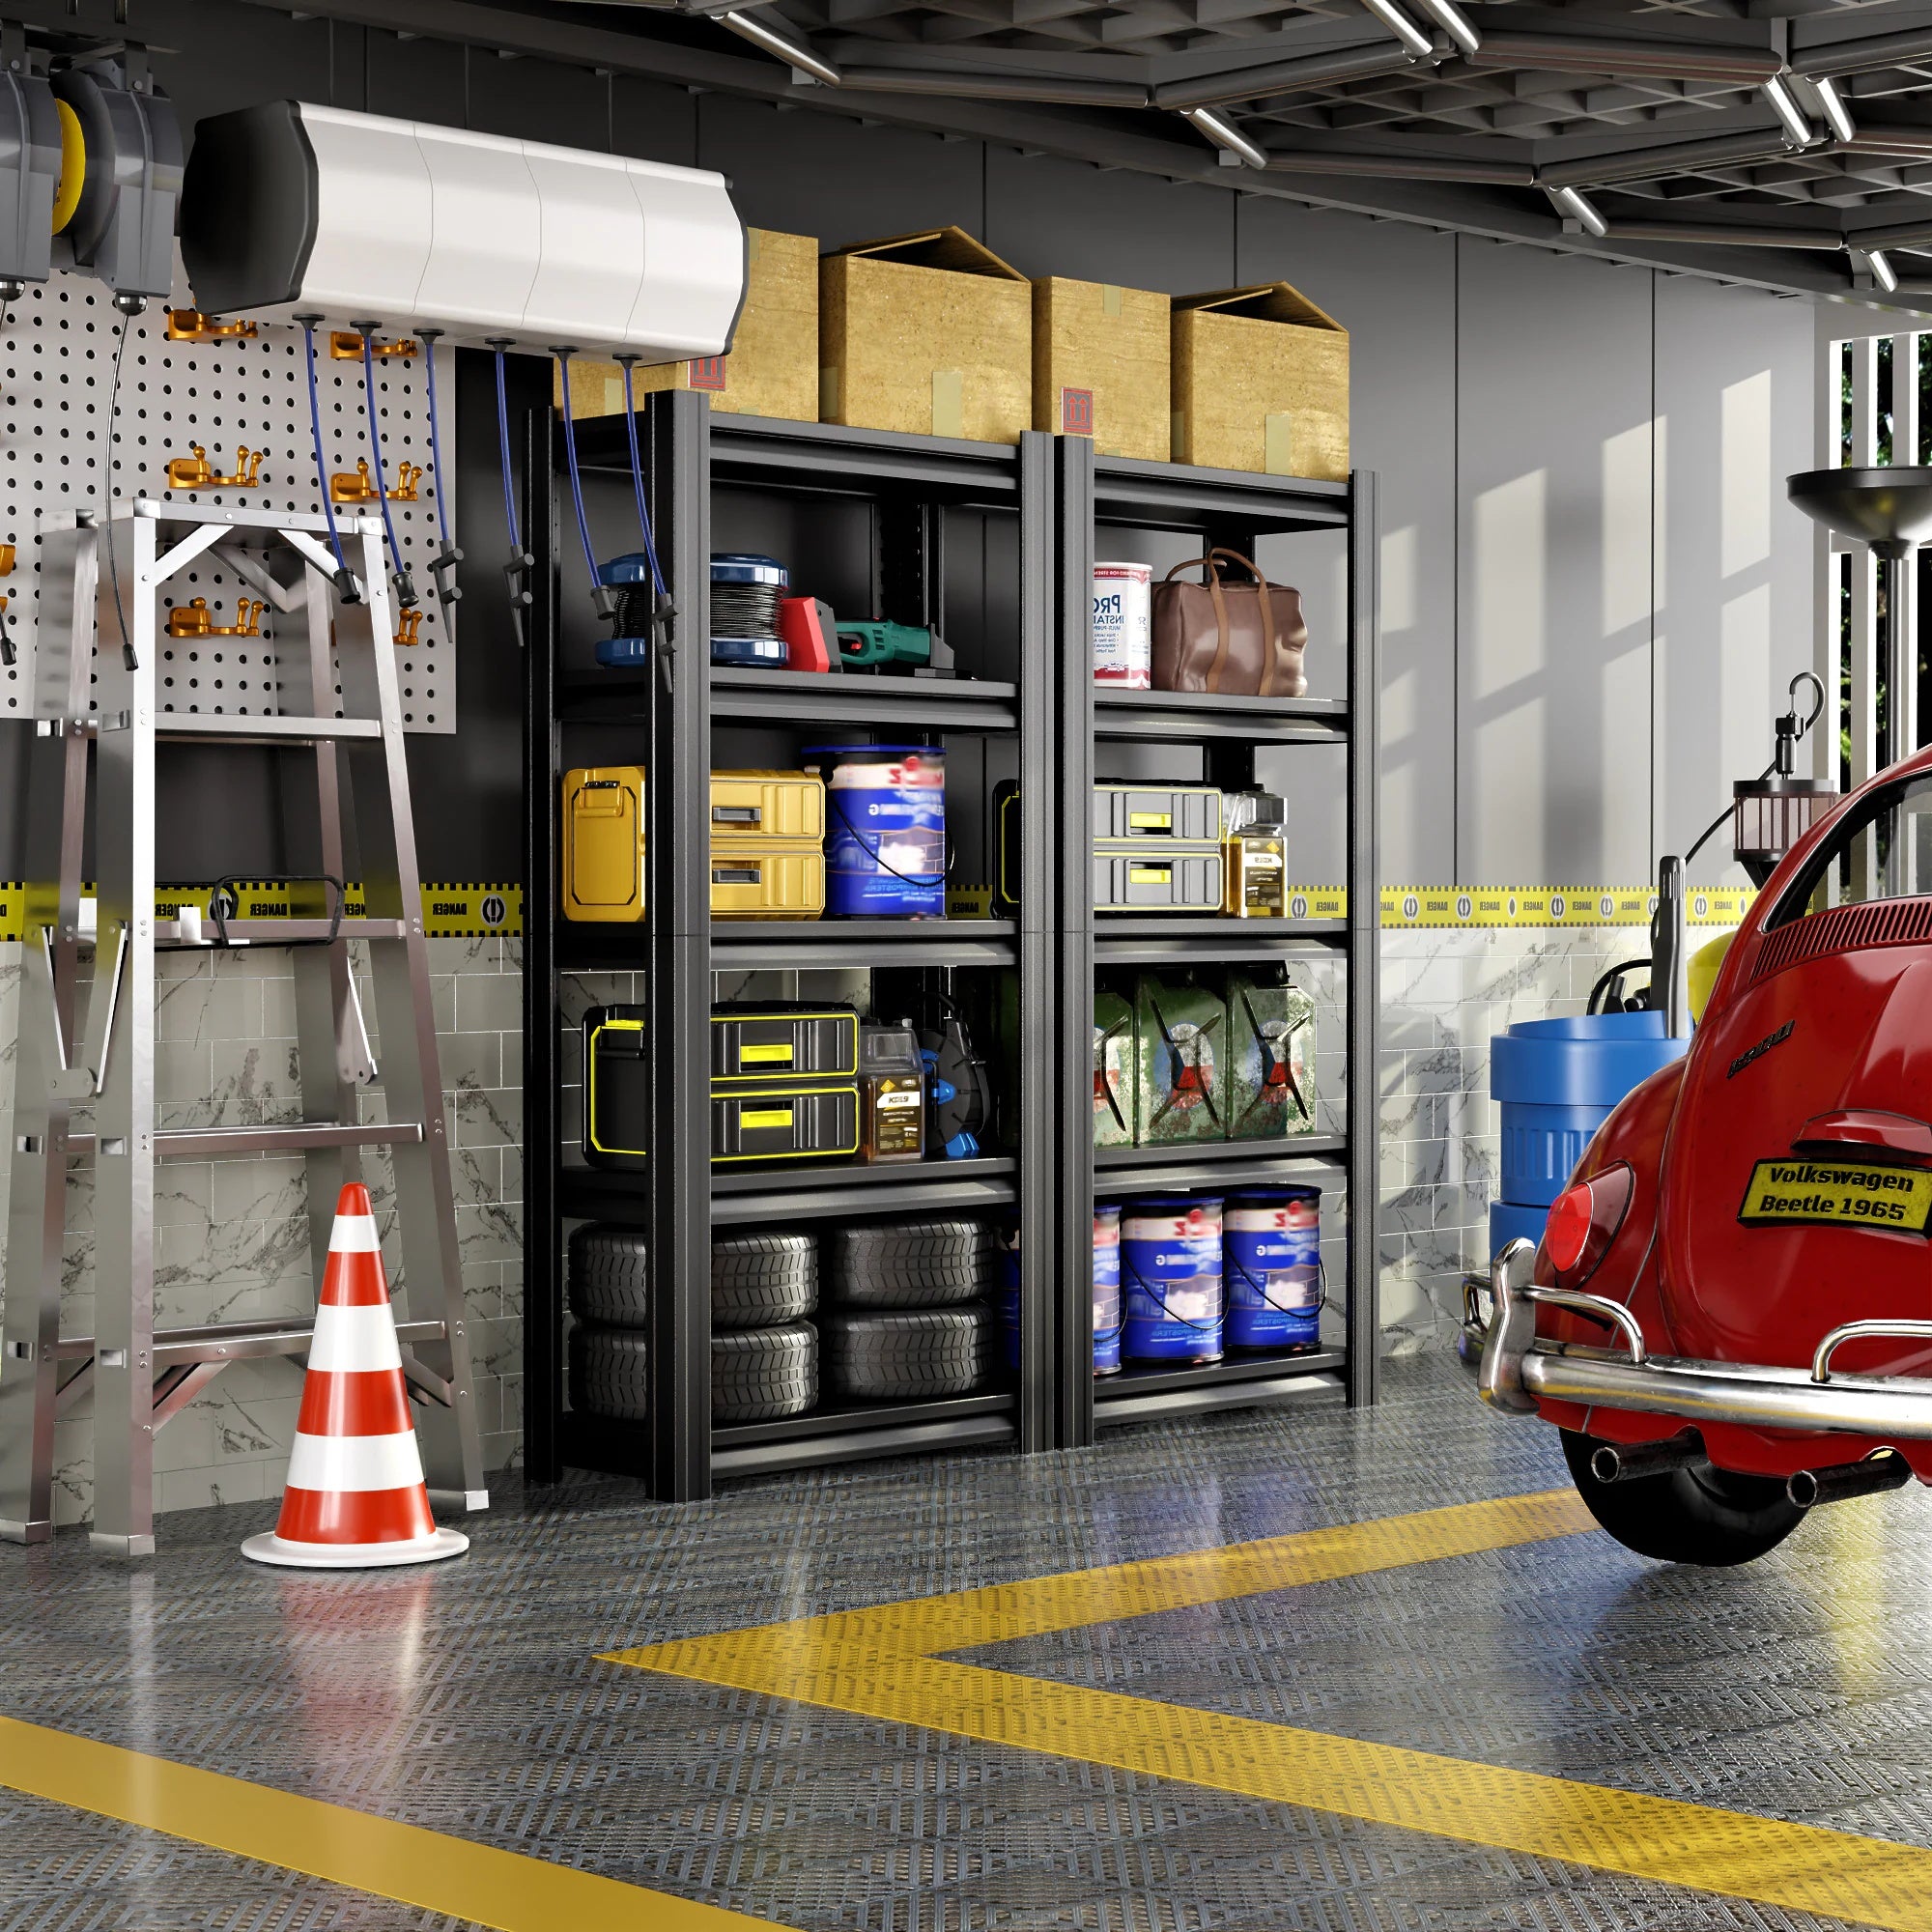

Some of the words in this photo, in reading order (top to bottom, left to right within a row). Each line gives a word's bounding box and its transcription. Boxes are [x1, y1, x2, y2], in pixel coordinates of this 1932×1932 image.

[1770, 1165, 1915, 1193] Volkswagen
[1759, 1195, 1834, 1213] Beetle
[1839, 1198, 1907, 1221] 1965
